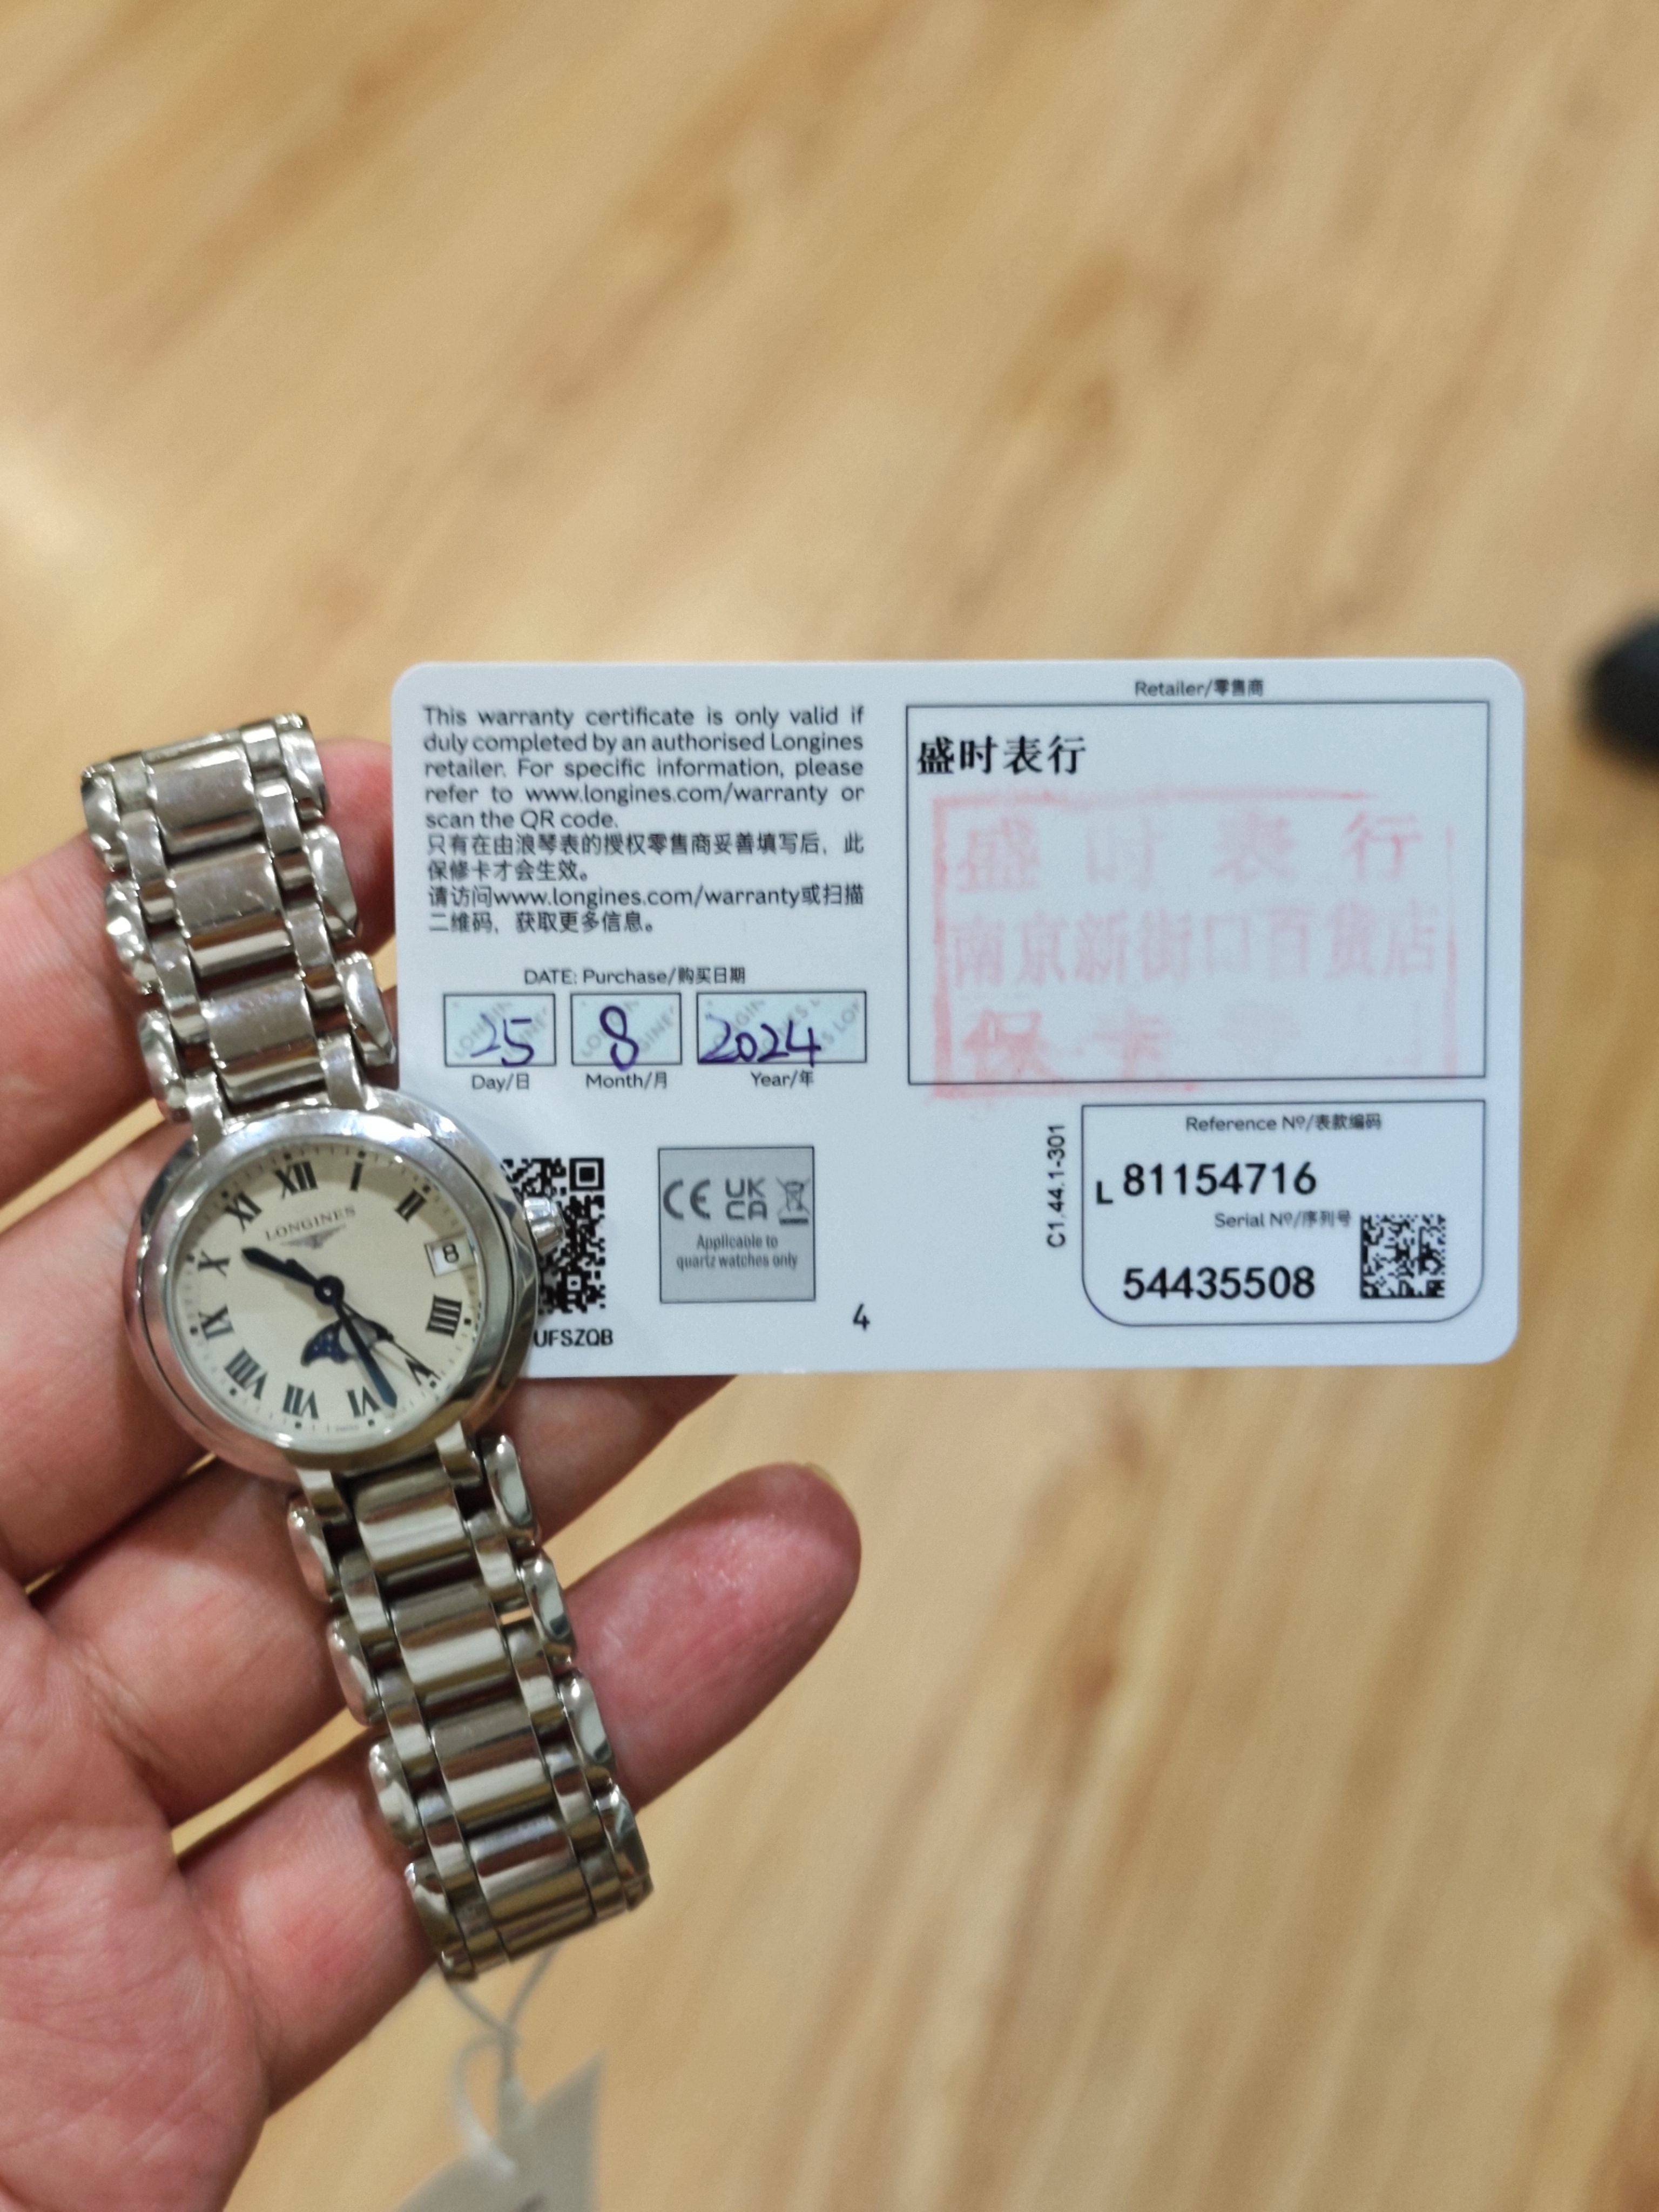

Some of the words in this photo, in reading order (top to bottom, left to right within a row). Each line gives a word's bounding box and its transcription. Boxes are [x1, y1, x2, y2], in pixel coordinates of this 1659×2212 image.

[1135, 678, 1264, 697] Retailer/零售商
[423, 705, 468, 727] This
[477, 707, 574, 731] warranty
[585, 705, 695, 726] certificate
[707, 706, 724, 726] is
[735, 705, 780, 730] only
[789, 705, 839, 726] valid
[851, 705, 864, 725] if
[423, 732, 469, 756] duly
[472, 732, 588, 759] completed
[592, 732, 618, 756] by
[621, 736, 646, 752] an
[651, 731, 765, 752] authorised
[771, 731, 864, 756] Longines
[917, 734, 1086, 775] 盛时表行
[424, 758, 506, 778] retailer.
[517, 756, 554, 778] For
[564, 757, 645, 781] specific
[657, 757, 784, 779] information,
[795, 757, 864, 780] please
[424, 783, 479, 804] refer
[490, 785, 514, 804] to
[525, 781, 828, 807] www.longines.com/warranty
[841, 786, 865, 802] or
[425, 813, 475, 829] scan
[480, 809, 515, 829] the
[520, 808, 555, 831] QR
[560, 808, 618, 829] code.
[427, 858, 588, 882] 保修卡才会生效。
[428, 882, 864, 911] 请访问www.longines.com/warranty或扫描
[524, 968, 577, 985] DATE:
[583, 966, 746, 986] Purchase/购买日期
[470, 1012, 534, 1067] 25
[599, 1006, 639, 1071] 8
[699, 1013, 821, 1068] 2024
[471, 1072, 530, 1093] Day/日
[585, 1071, 667, 1090] Month/月
[750, 1069, 814, 1089] Year/年
[1185, 1115, 1278, 1132] Reference
[275, 1161, 318, 1200] XII
[725, 1178, 766, 1198] UK
[1046, 1125, 1067, 1249] C1.44.1-301
[1096, 1180, 1114, 1205] L
[1123, 1161, 1317, 1197] 81154716
[265, 1205, 356, 1240] LONGINES
[725, 1201, 767, 1221] CA
[1214, 1212, 1265, 1229] Serial
[442, 1243, 459, 1263] 8
[697, 1233, 763, 1250] Applicable
[766, 1235, 778, 1249] to
[677, 1254, 716, 1271] quartz
[718, 1252, 769, 1267] watches
[773, 1252, 798, 1270] only
[1123, 1265, 1316, 1301] 54435508
[852, 1303, 871, 1331] 4
[534, 1328, 613, 1347] UFSZQB
